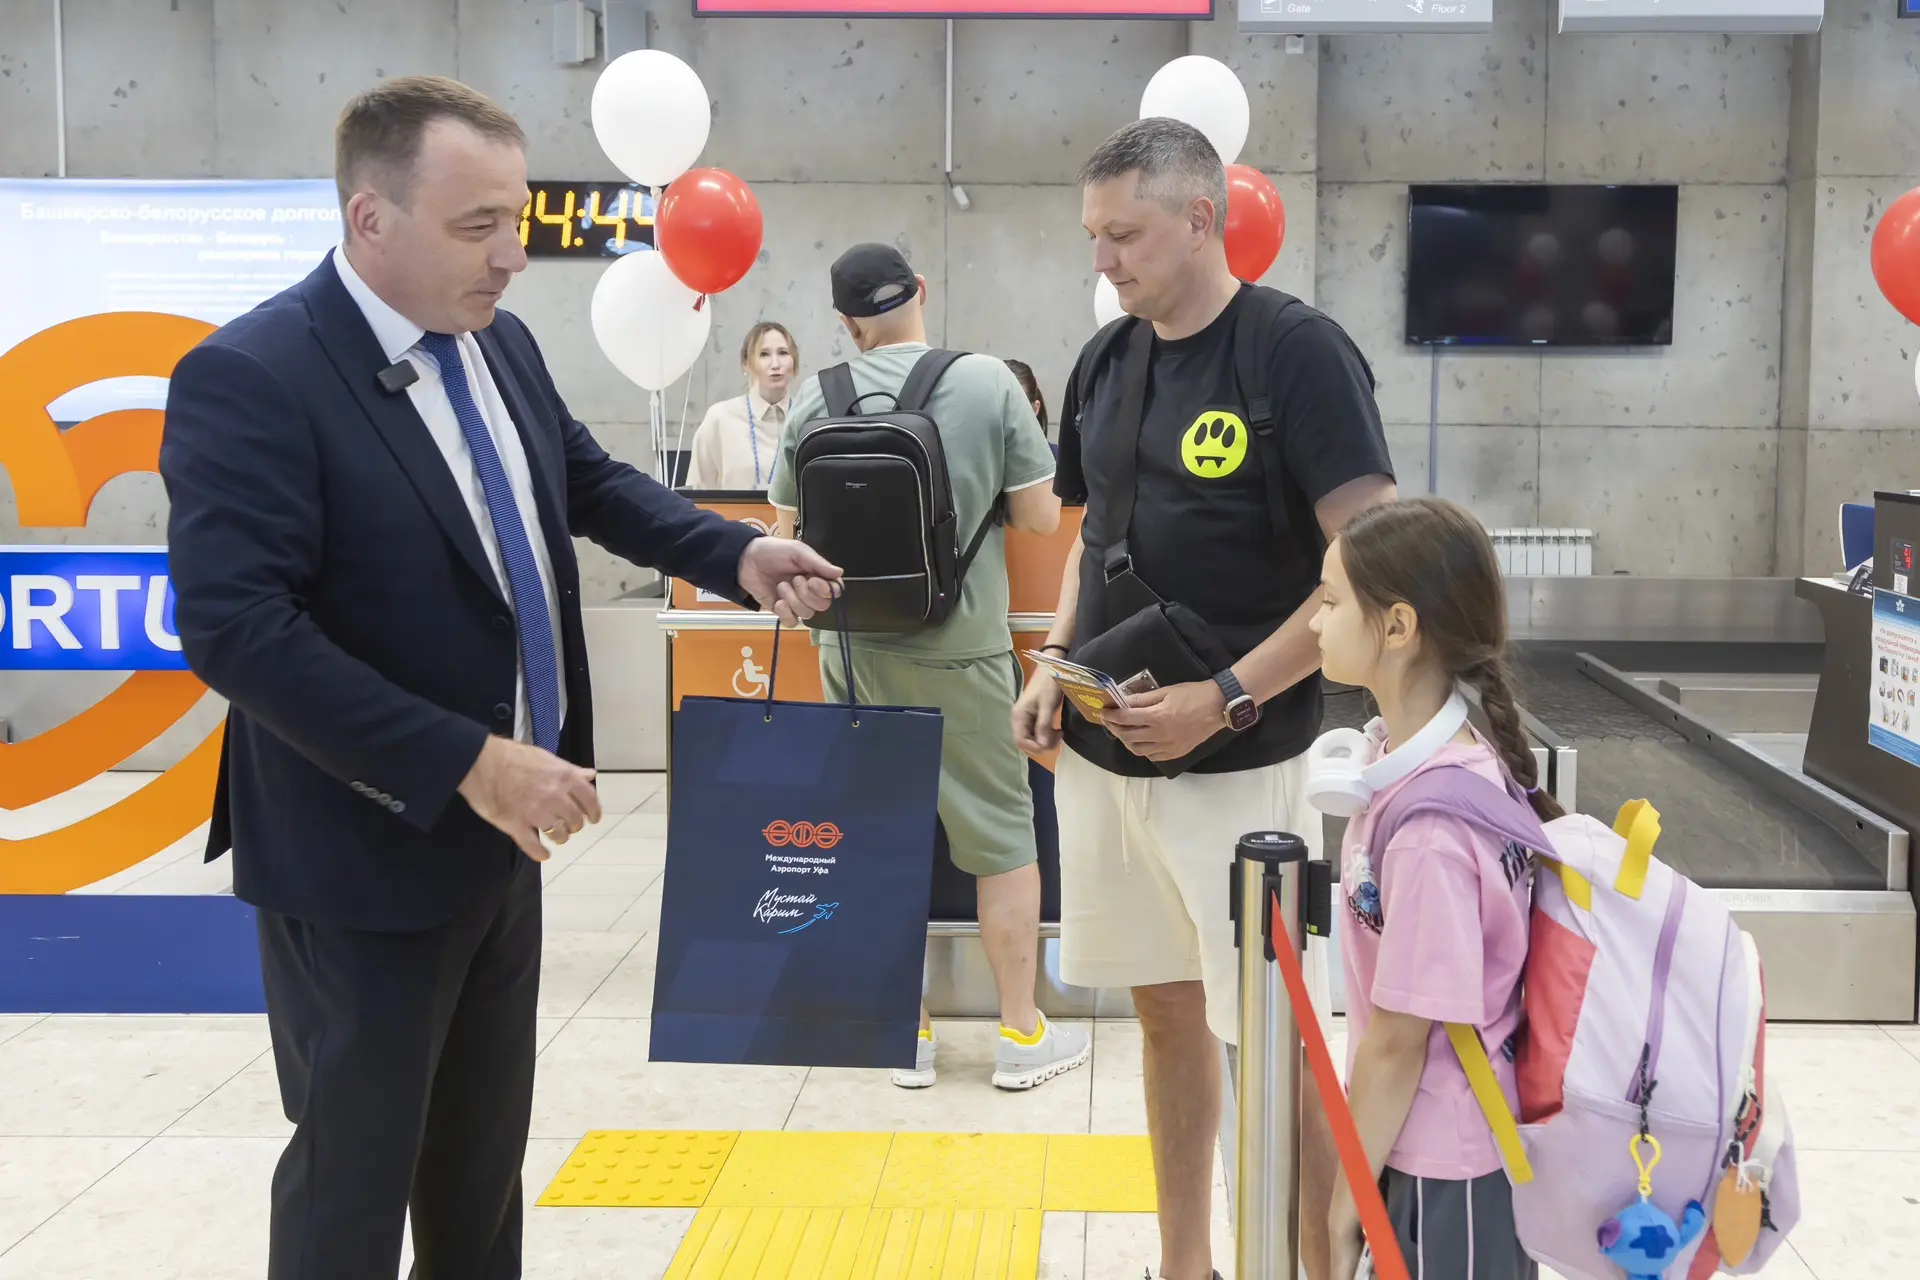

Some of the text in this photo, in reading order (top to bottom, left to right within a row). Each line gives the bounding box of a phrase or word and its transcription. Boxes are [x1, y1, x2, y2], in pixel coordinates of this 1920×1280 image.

[1287, 3, 1311, 13] Gate
[1431, 4, 1466, 13] Floor 2
[765, 854, 836, 865] Международный
[771, 865, 829, 876] Аэропорт Уфа
[759, 887, 818, 909] Мустай
[753, 902, 804, 923] Карим
